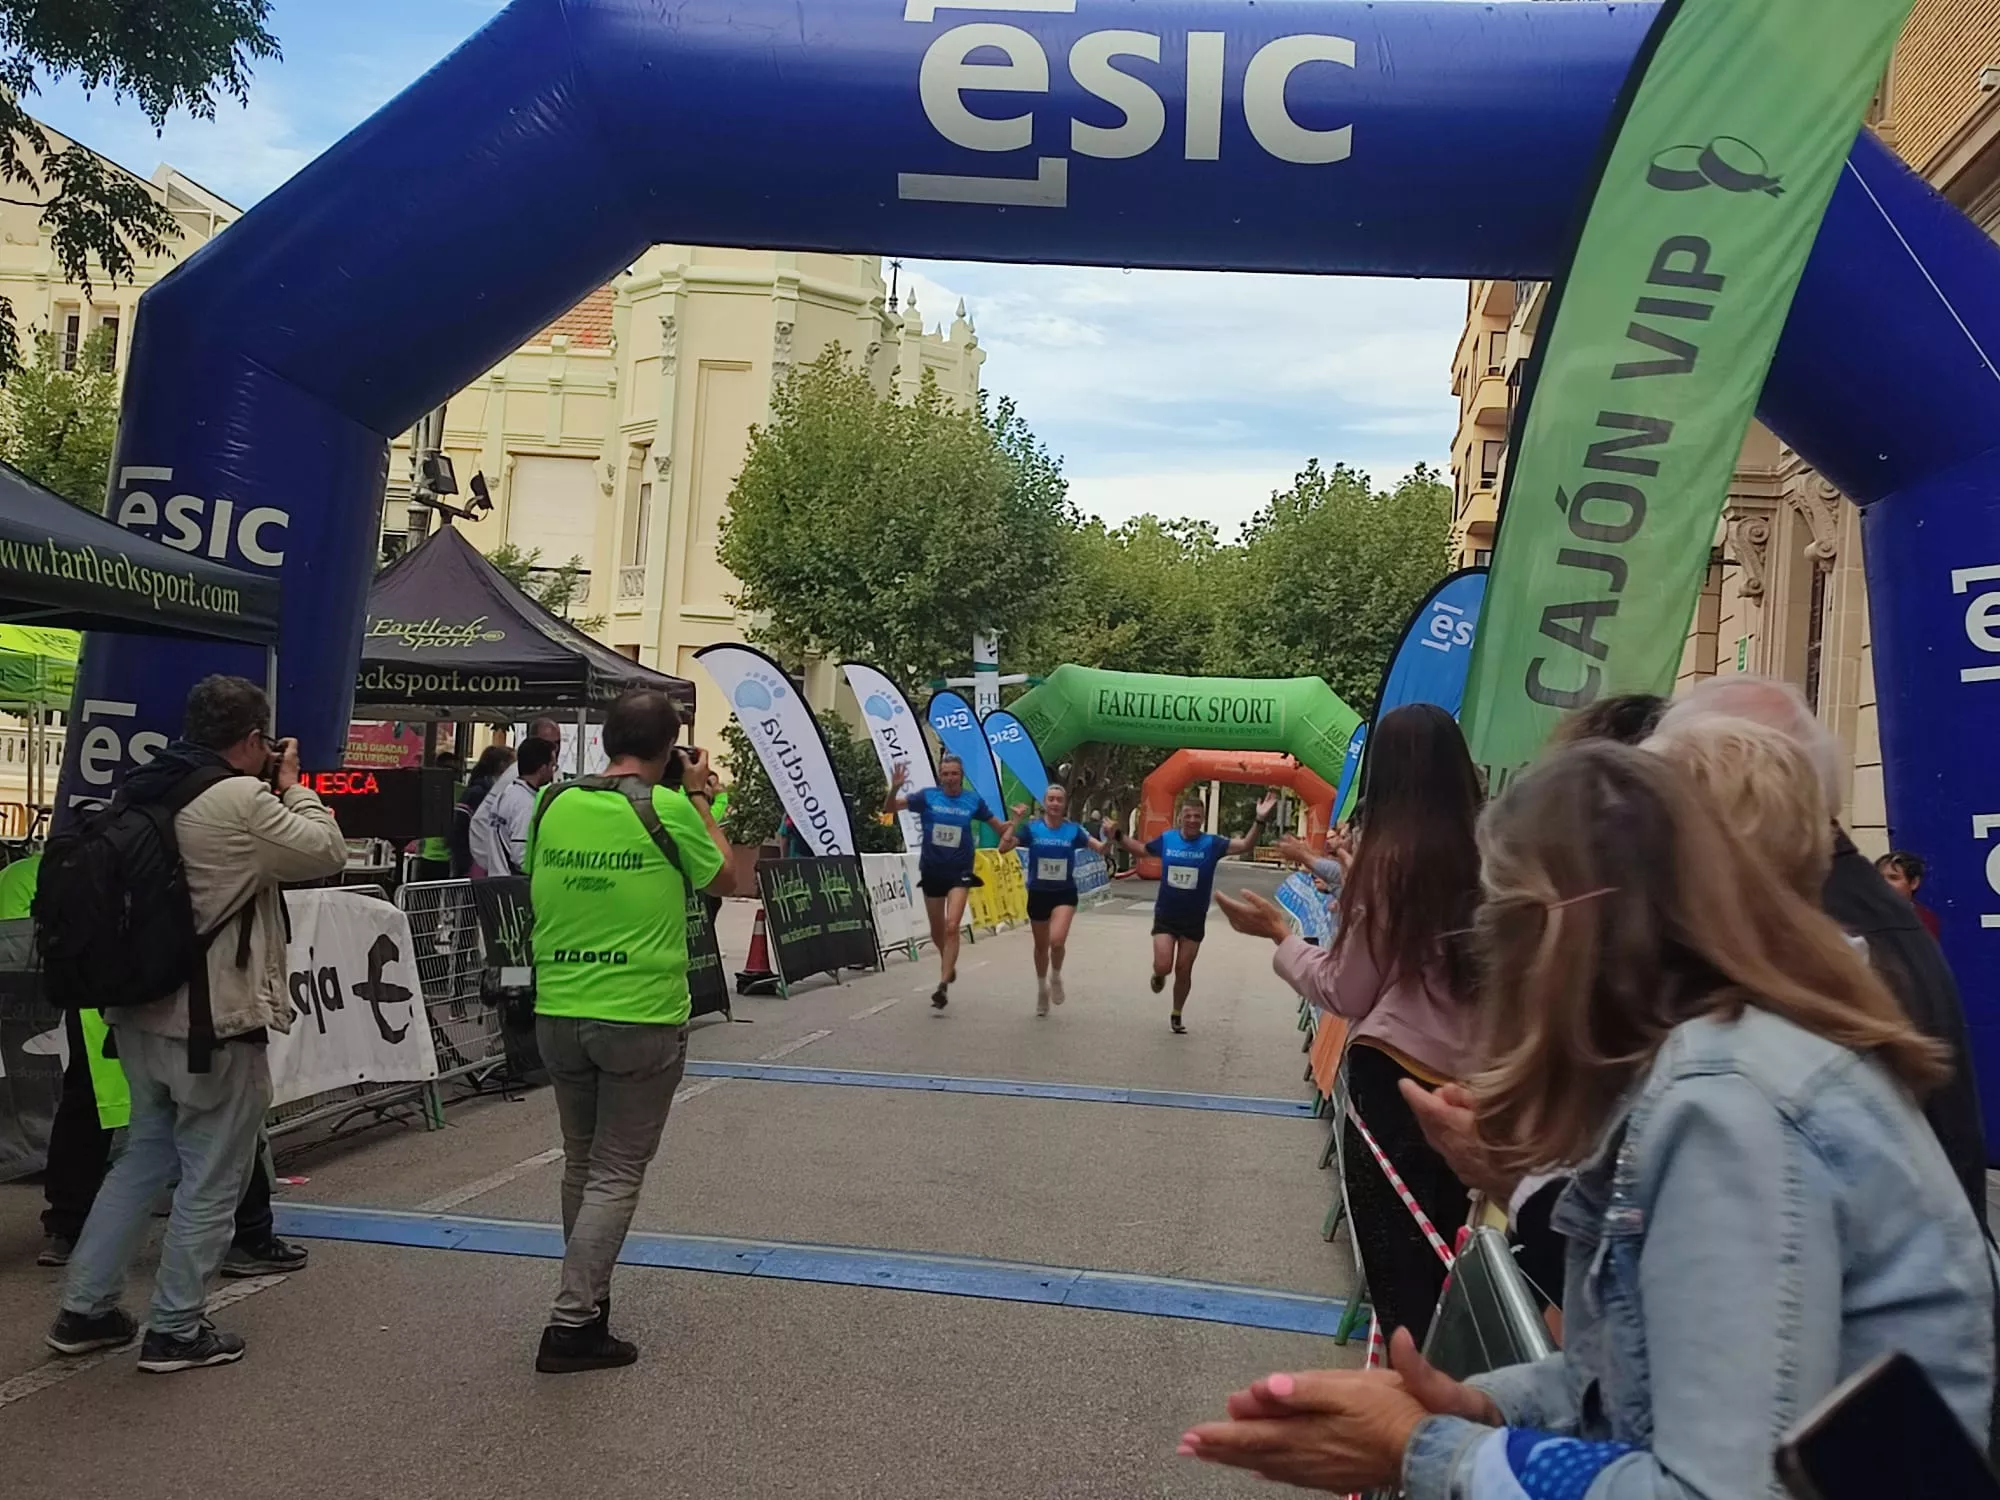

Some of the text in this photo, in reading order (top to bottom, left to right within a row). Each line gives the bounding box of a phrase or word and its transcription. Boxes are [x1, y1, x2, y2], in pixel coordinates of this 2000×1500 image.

[1524, 233, 1726, 711] CAJÓN VIP
[1097, 688, 1276, 725] FARTLECK SPORT
[369, 743, 409, 754] GUIADAS
[543, 847, 644, 871] ORGANIZACIÓN
[1172, 871, 1192, 881] 317
